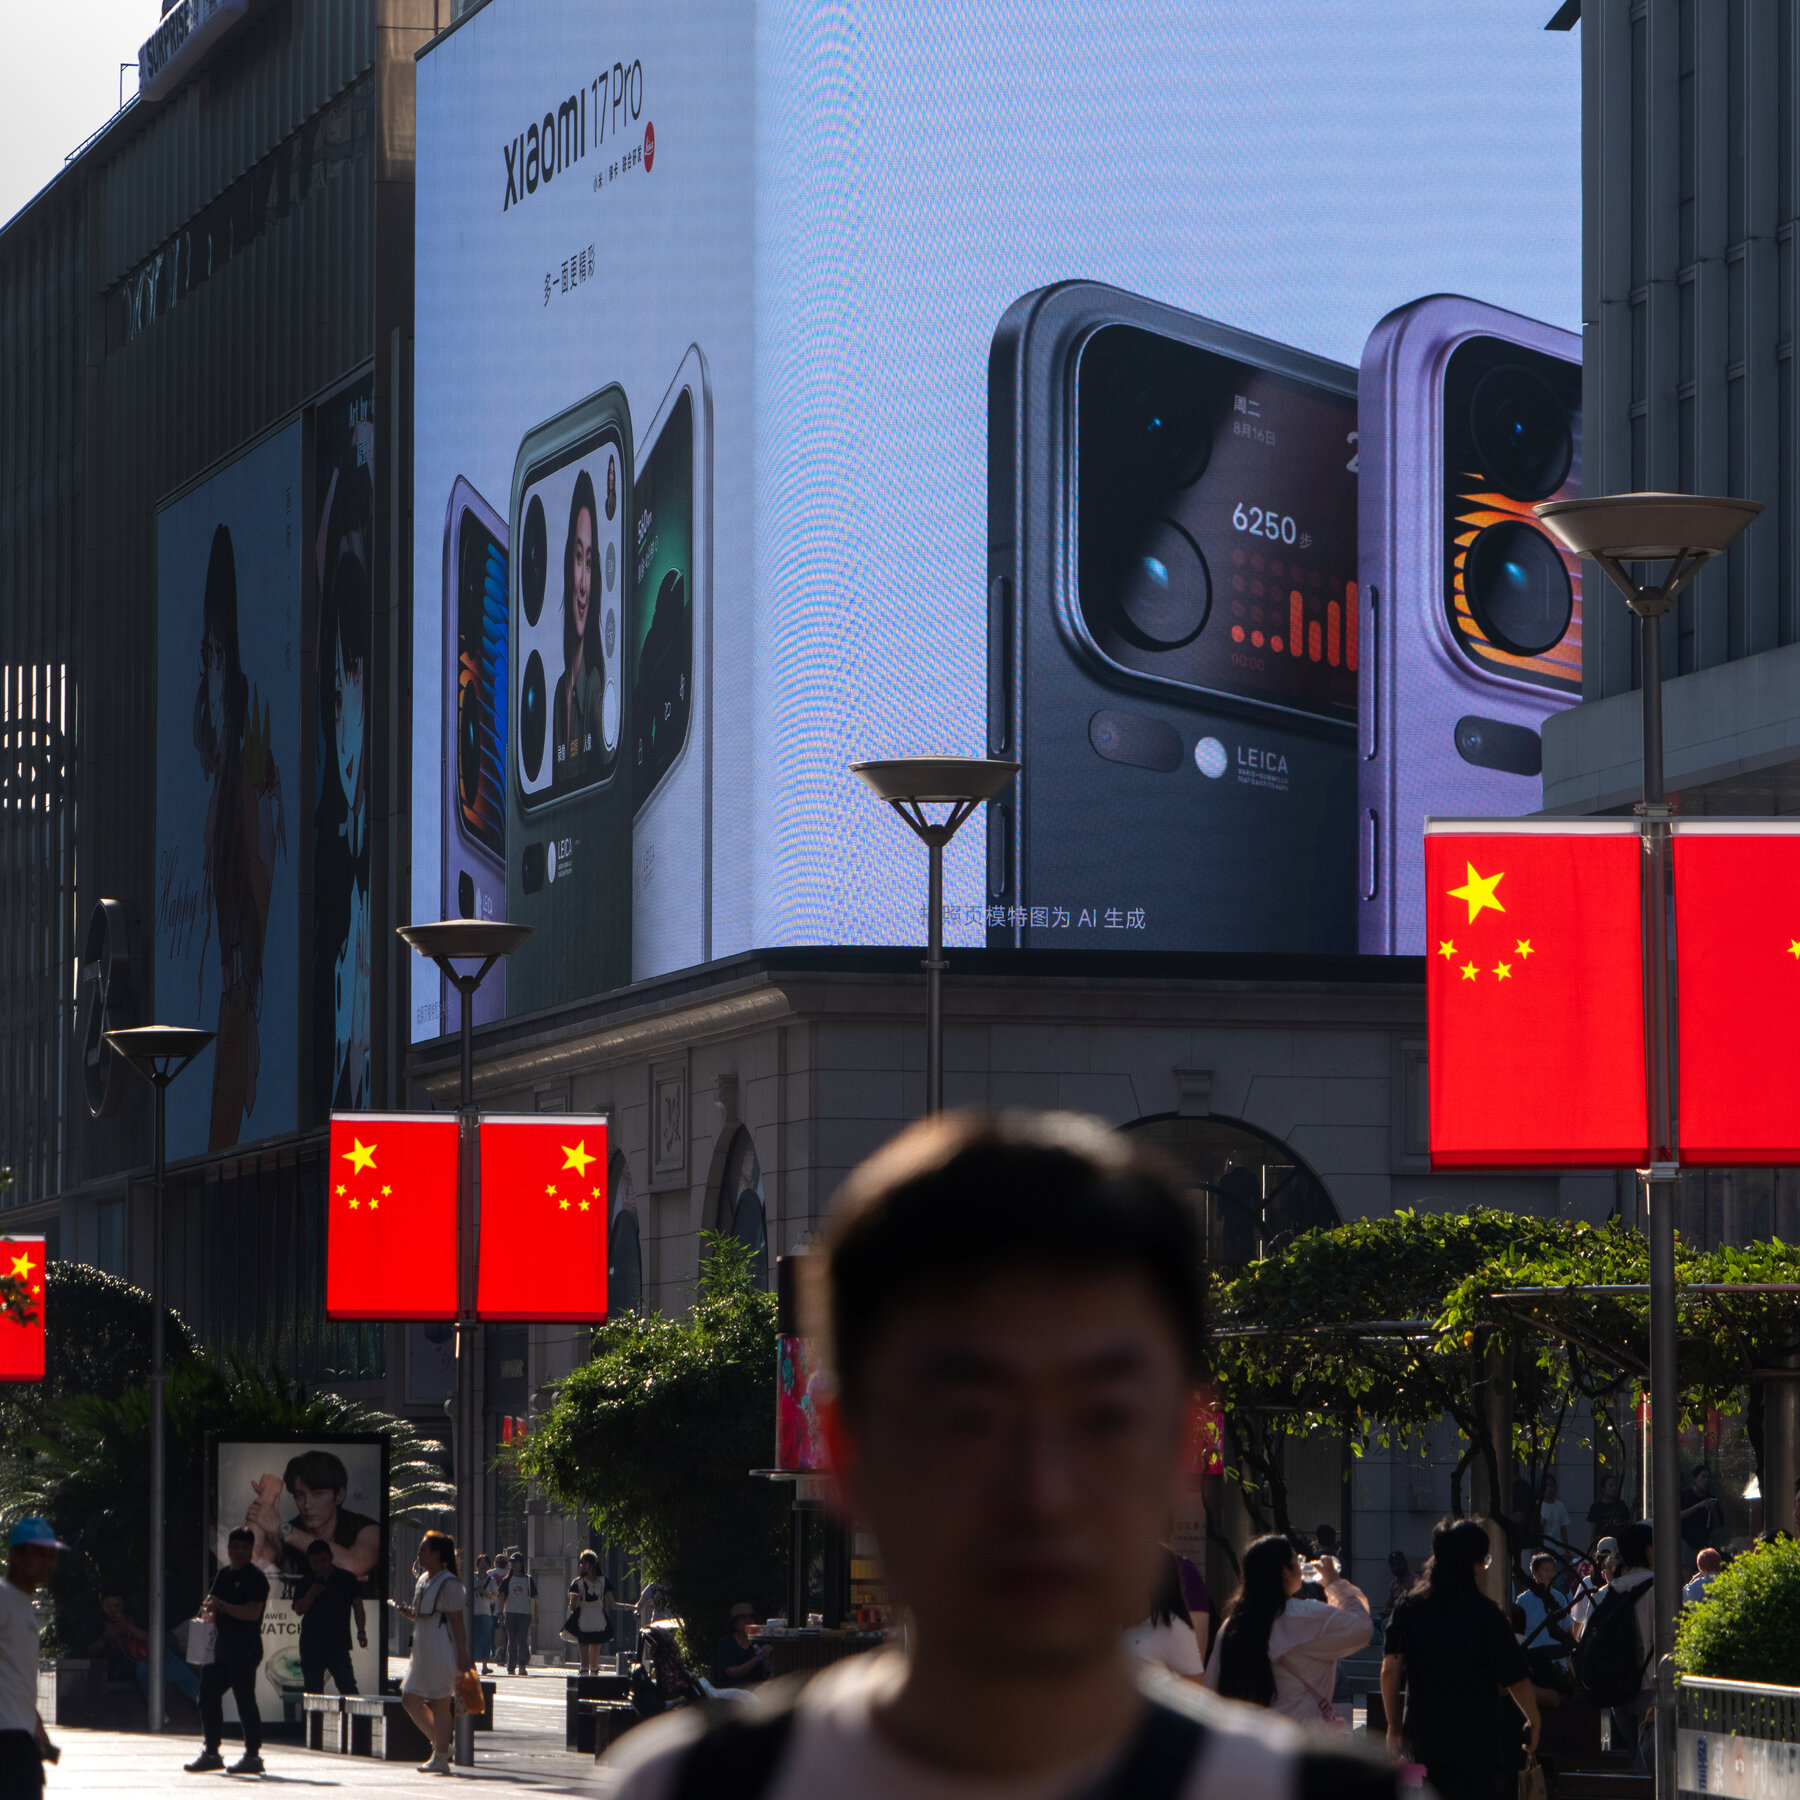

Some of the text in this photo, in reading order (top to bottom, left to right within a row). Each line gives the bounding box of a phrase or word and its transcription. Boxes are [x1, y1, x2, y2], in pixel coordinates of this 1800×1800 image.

[591, 70, 609, 148] 17
[612, 58, 643, 135] Pro
[544, 243, 596, 308] 多一面更精彩
[1234, 394, 1262, 418] 周二
[1233, 421, 1276, 447] 8月16日
[1232, 501, 1313, 549] 6250 步
[1237, 745, 1289, 775] LEICA
[1077, 908, 1097, 928] AI
[1103, 907, 1147, 930] 生成
